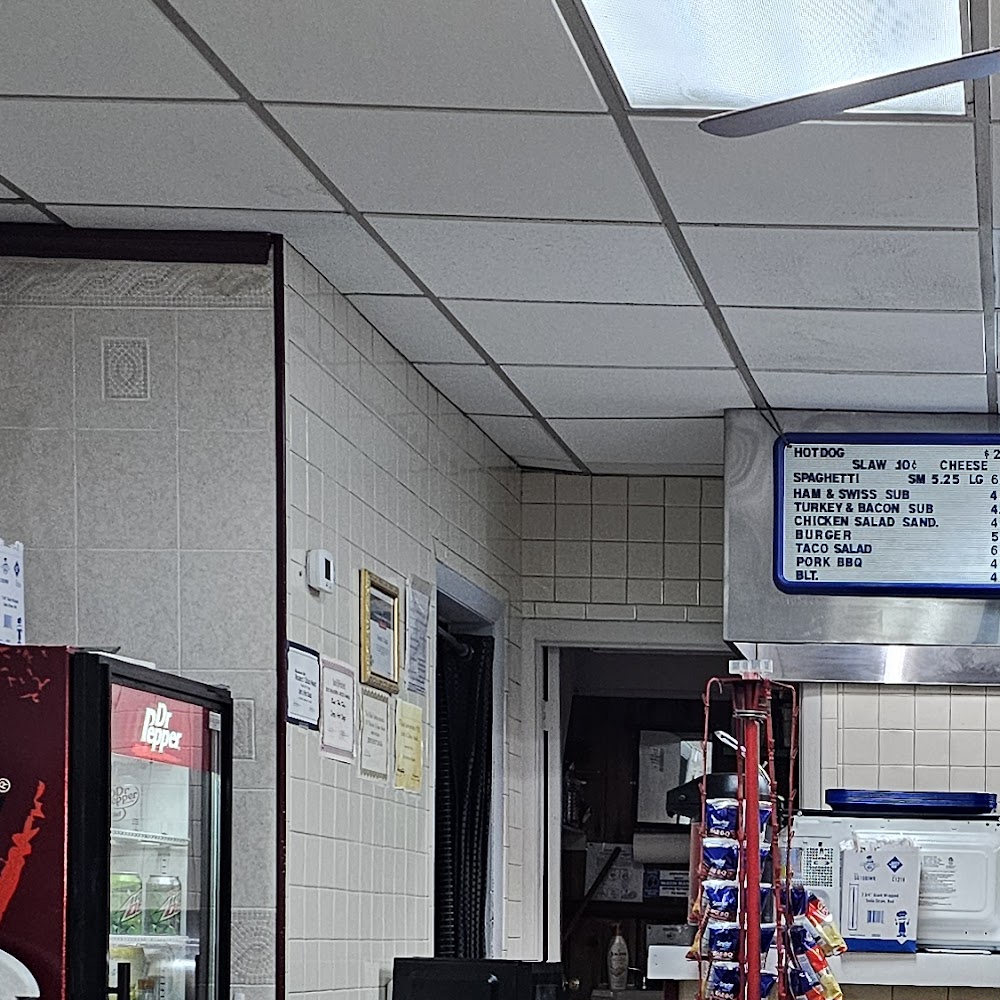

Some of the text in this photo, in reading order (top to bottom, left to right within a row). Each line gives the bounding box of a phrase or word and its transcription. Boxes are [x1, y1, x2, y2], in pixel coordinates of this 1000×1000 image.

[852, 460, 887, 470] SLAW
[940, 460, 988, 471] CHEESE
[793, 473, 859, 484] SPAGHETTI
[908, 474, 926, 484] SM
[931, 474, 960, 485] 5.25
[969, 474, 984, 485] LG
[794, 488, 821, 499] HAM
[826, 489, 835, 499] &
[838, 489, 877, 500] SWISS
[885, 489, 910, 500] SUB
[794, 503, 843, 513] TURKEY
[845, 503, 853, 513] &
[858, 503, 900, 513] BACON
[909, 503, 934, 514] SUB
[794, 516, 849, 527] CHICKEN
[854, 517, 895, 527] SALAD
[903, 517, 939, 528] SAND.
[795, 530, 851, 540] BURGER
[796, 543, 828, 554] TACO
[834, 543, 872, 554] SALAD
[796, 557, 830, 567] PORK
[837, 557, 862, 568] BBQ
[796, 571, 819, 581] BLT.
[155, 702, 173, 729] Dr
[140, 707, 183, 753] Pepper
